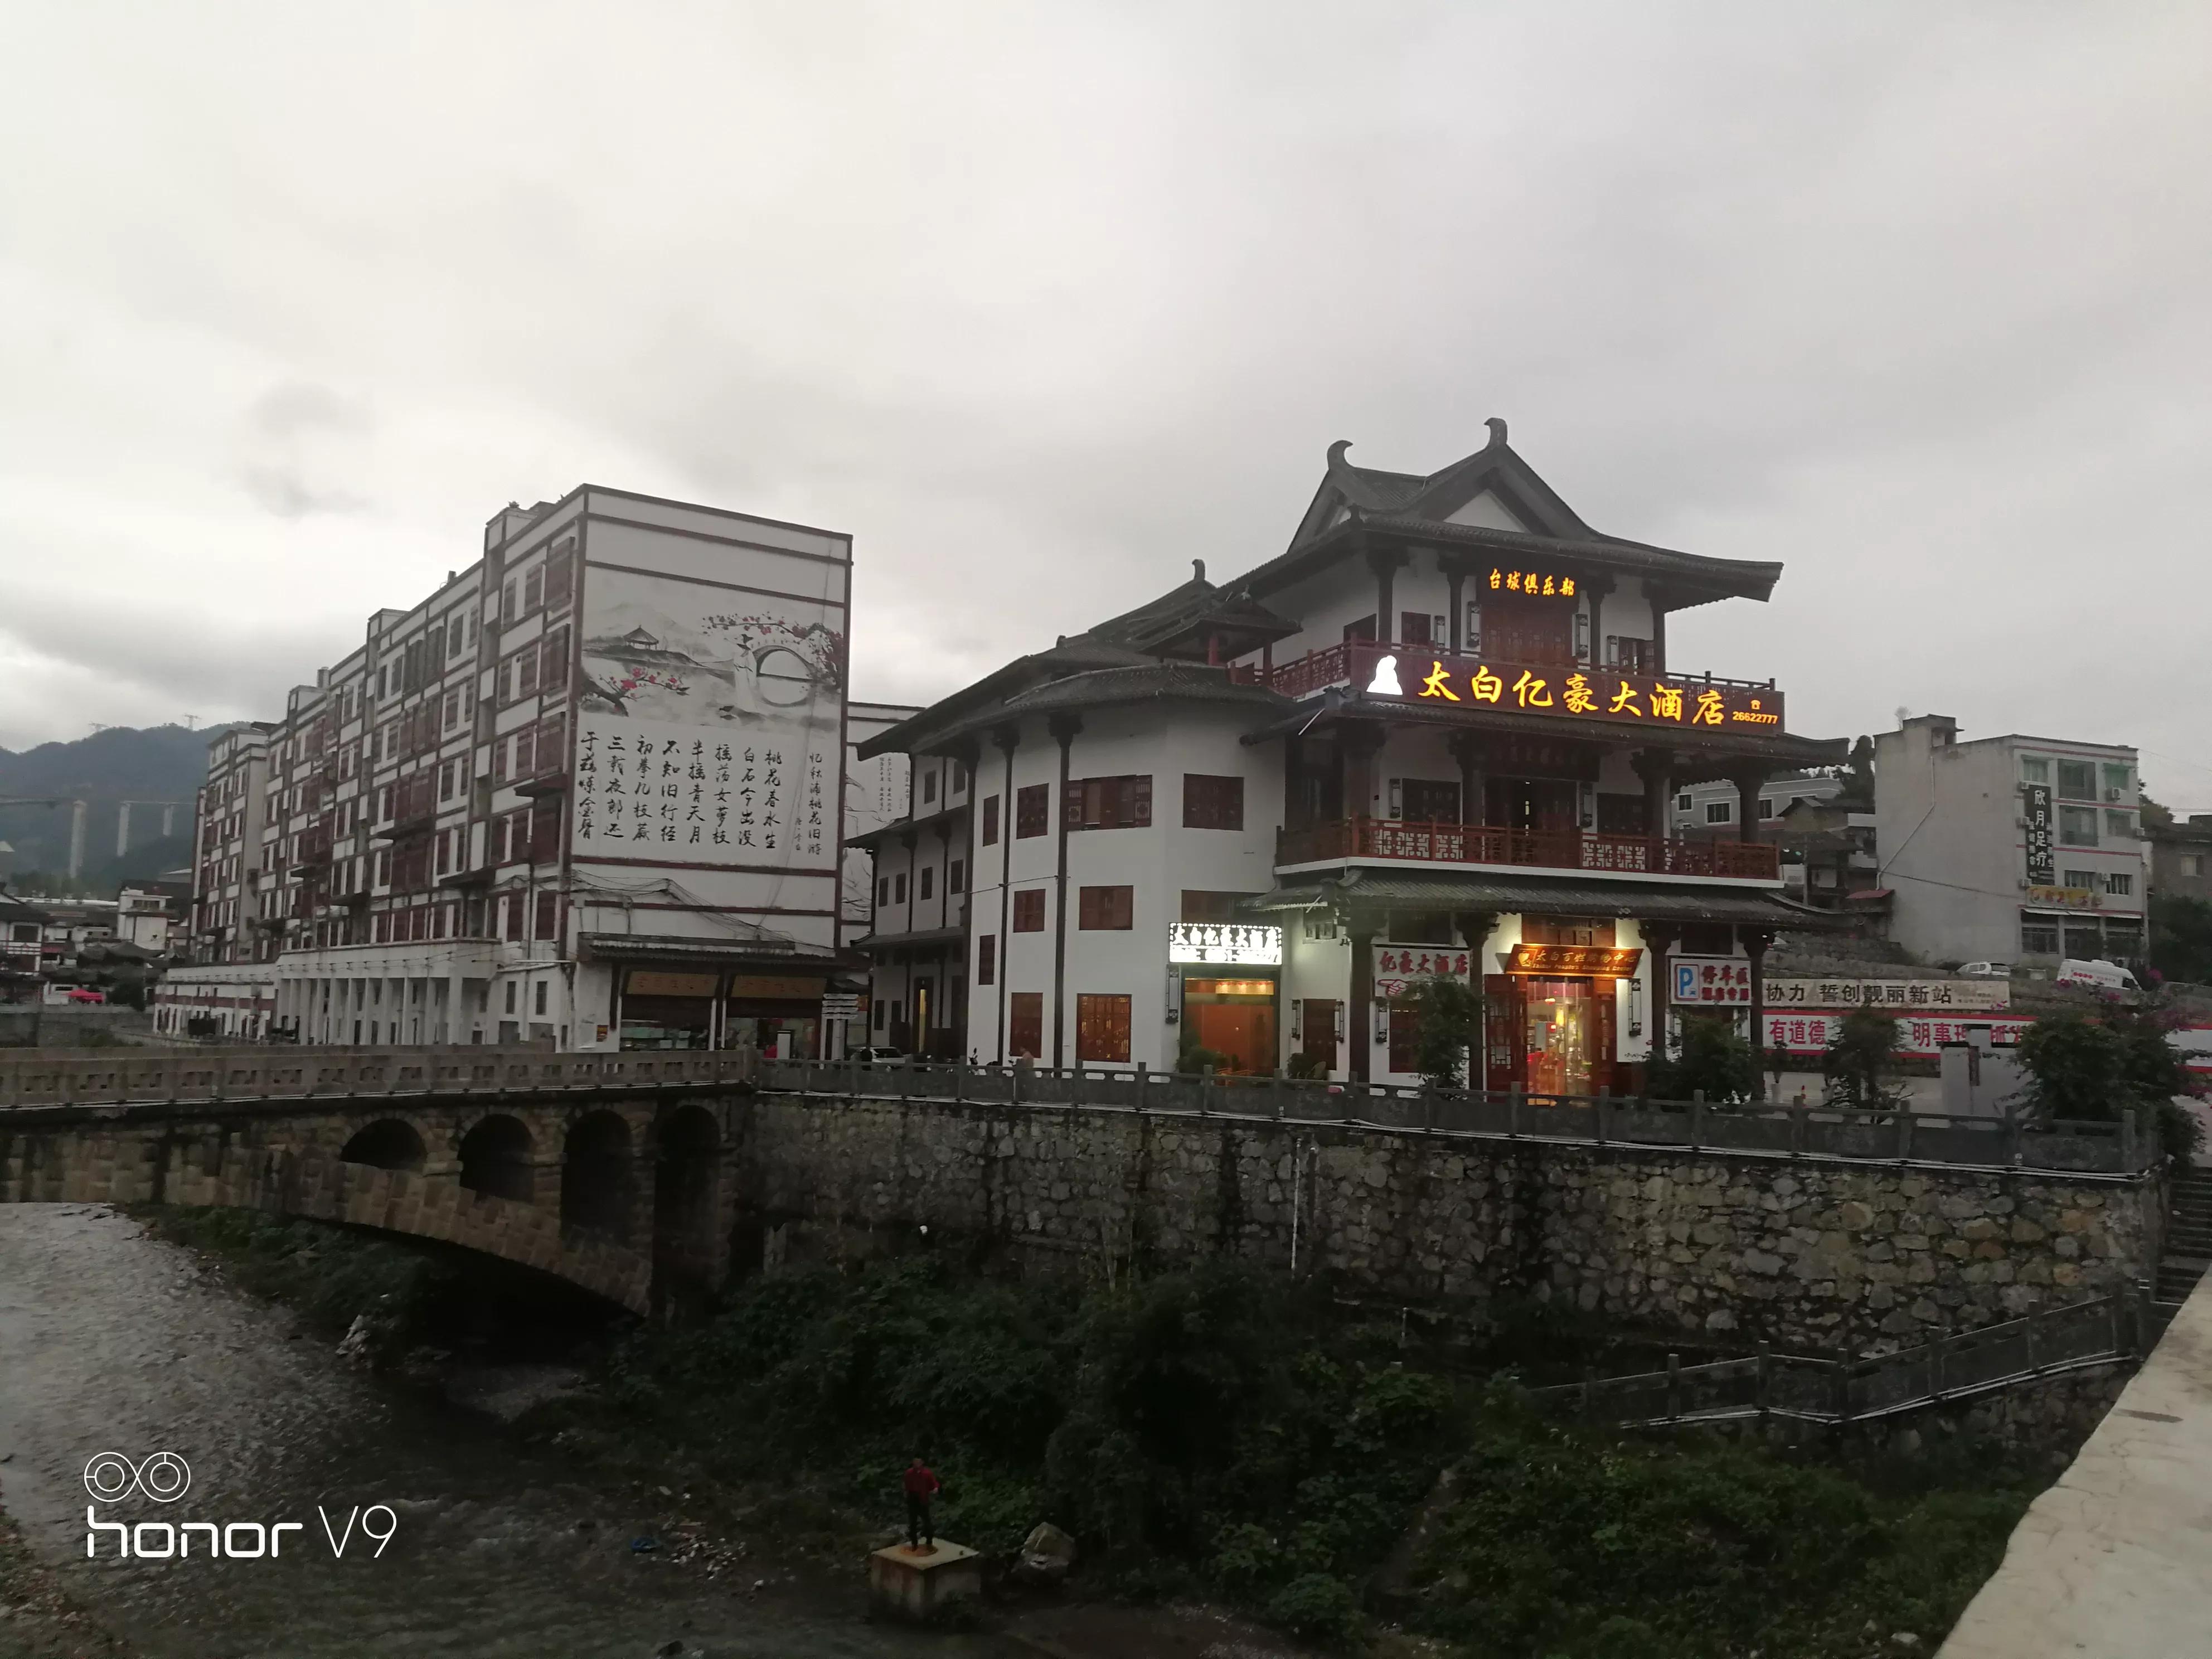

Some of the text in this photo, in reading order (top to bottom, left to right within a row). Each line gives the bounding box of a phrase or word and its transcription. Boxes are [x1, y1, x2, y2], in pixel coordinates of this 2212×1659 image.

[1490, 568, 1575, 597] 台球俱乐部
[1418, 661, 1725, 726] 太白亿豪大酒店
[1732, 711, 1778, 725] 26622777
[661, 740, 680, 842] 不知旧行径
[686, 739, 706, 843] 半摇青天月
[739, 747, 758, 848] 白石今出没
[763, 749, 782, 850] 桃花春水生
[1680, 967, 1694, 996] P
[1766, 982, 1805, 1002] 协力
[1820, 983, 1952, 1004] 誓创靓丽新站
[1769, 1019, 1826, 1045] 有道德
